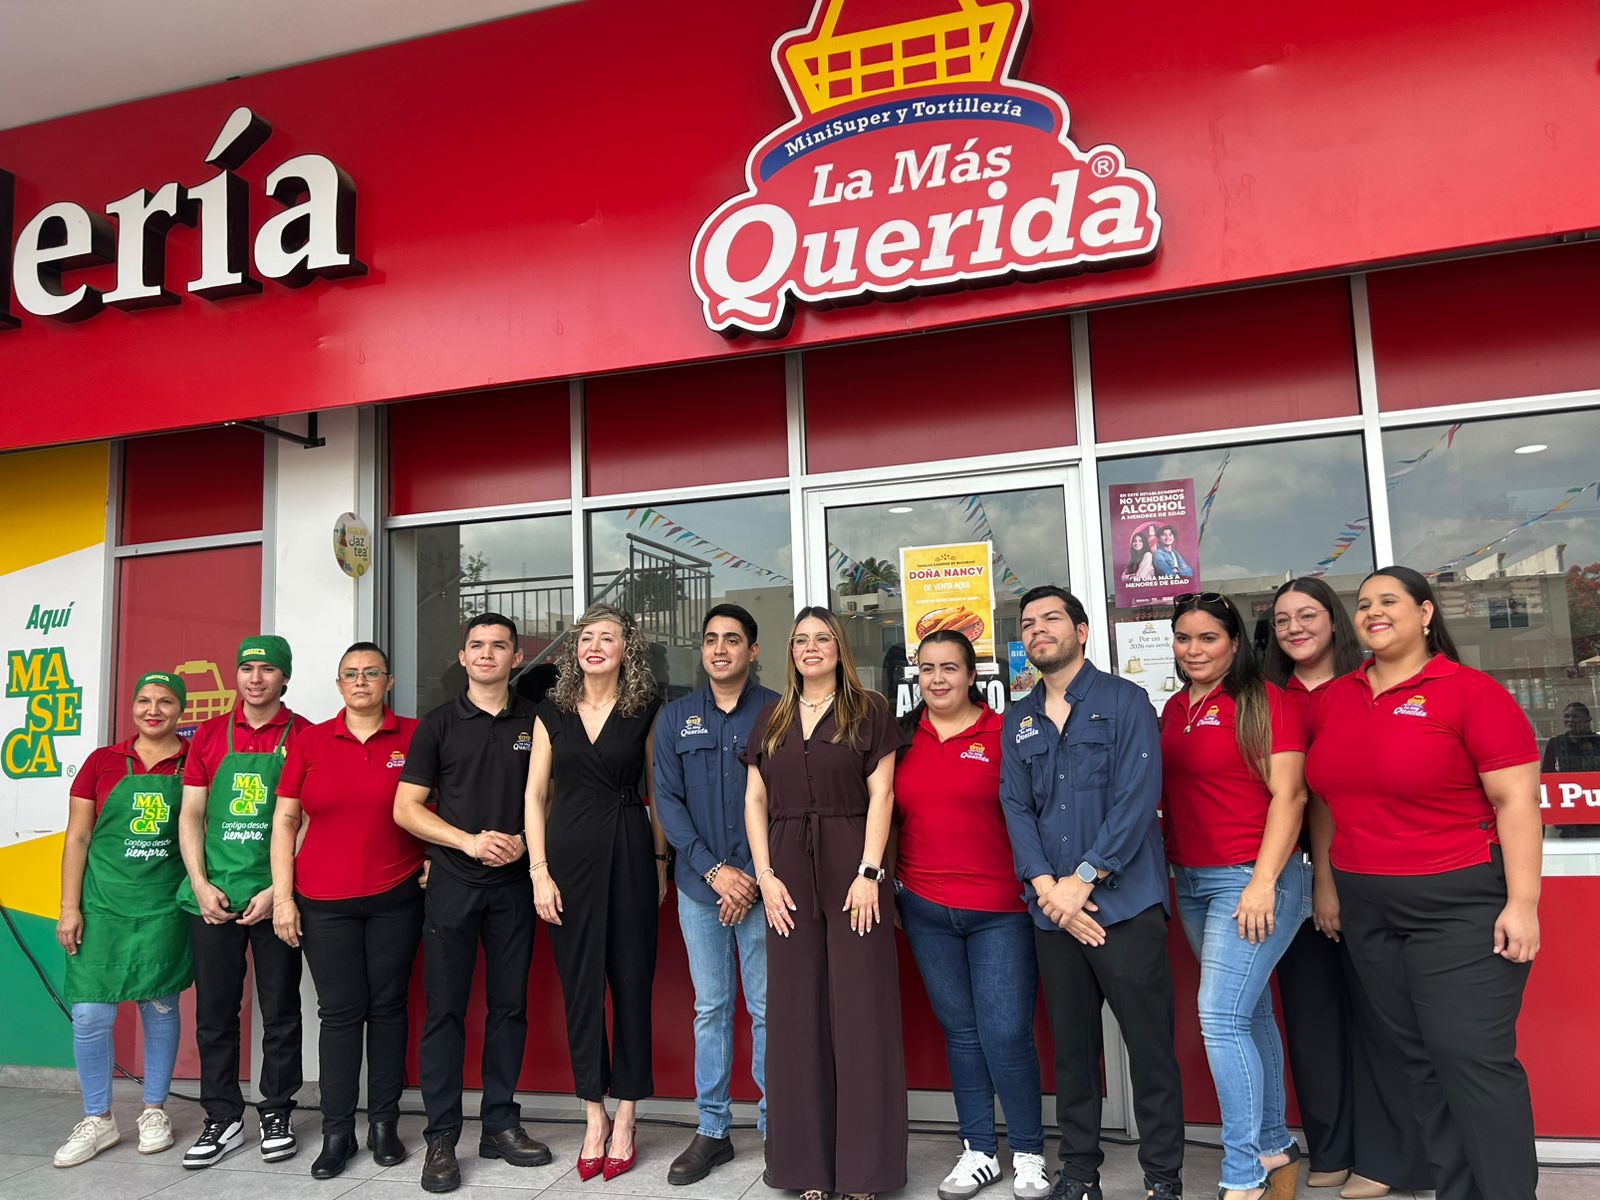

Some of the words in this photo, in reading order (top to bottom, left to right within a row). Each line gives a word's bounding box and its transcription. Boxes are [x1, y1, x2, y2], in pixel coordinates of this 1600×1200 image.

[784, 112, 891, 157] MiniSuper
[896, 107, 908, 123] y
[912, 98, 1022, 117] Tortillería
[808, 163, 874, 207] La
[888, 137, 1012, 194] Más
[0, 106, 356, 318] ería
[703, 168, 1146, 318] Querida
[1134, 493, 1185, 503] VENDEMOS
[1120, 500, 1186, 514] ALCOHOL
[909, 568, 941, 580] DOÑA
[944, 566, 984, 577] NANCY
[1170, 578, 1189, 586] EDAD
[25, 601, 75, 635] Aquí
[680, 728, 709, 737] Querida
[222, 821, 247, 830] Contigo
[247, 821, 269, 829] desde
[124, 838, 151, 848] Contigo
